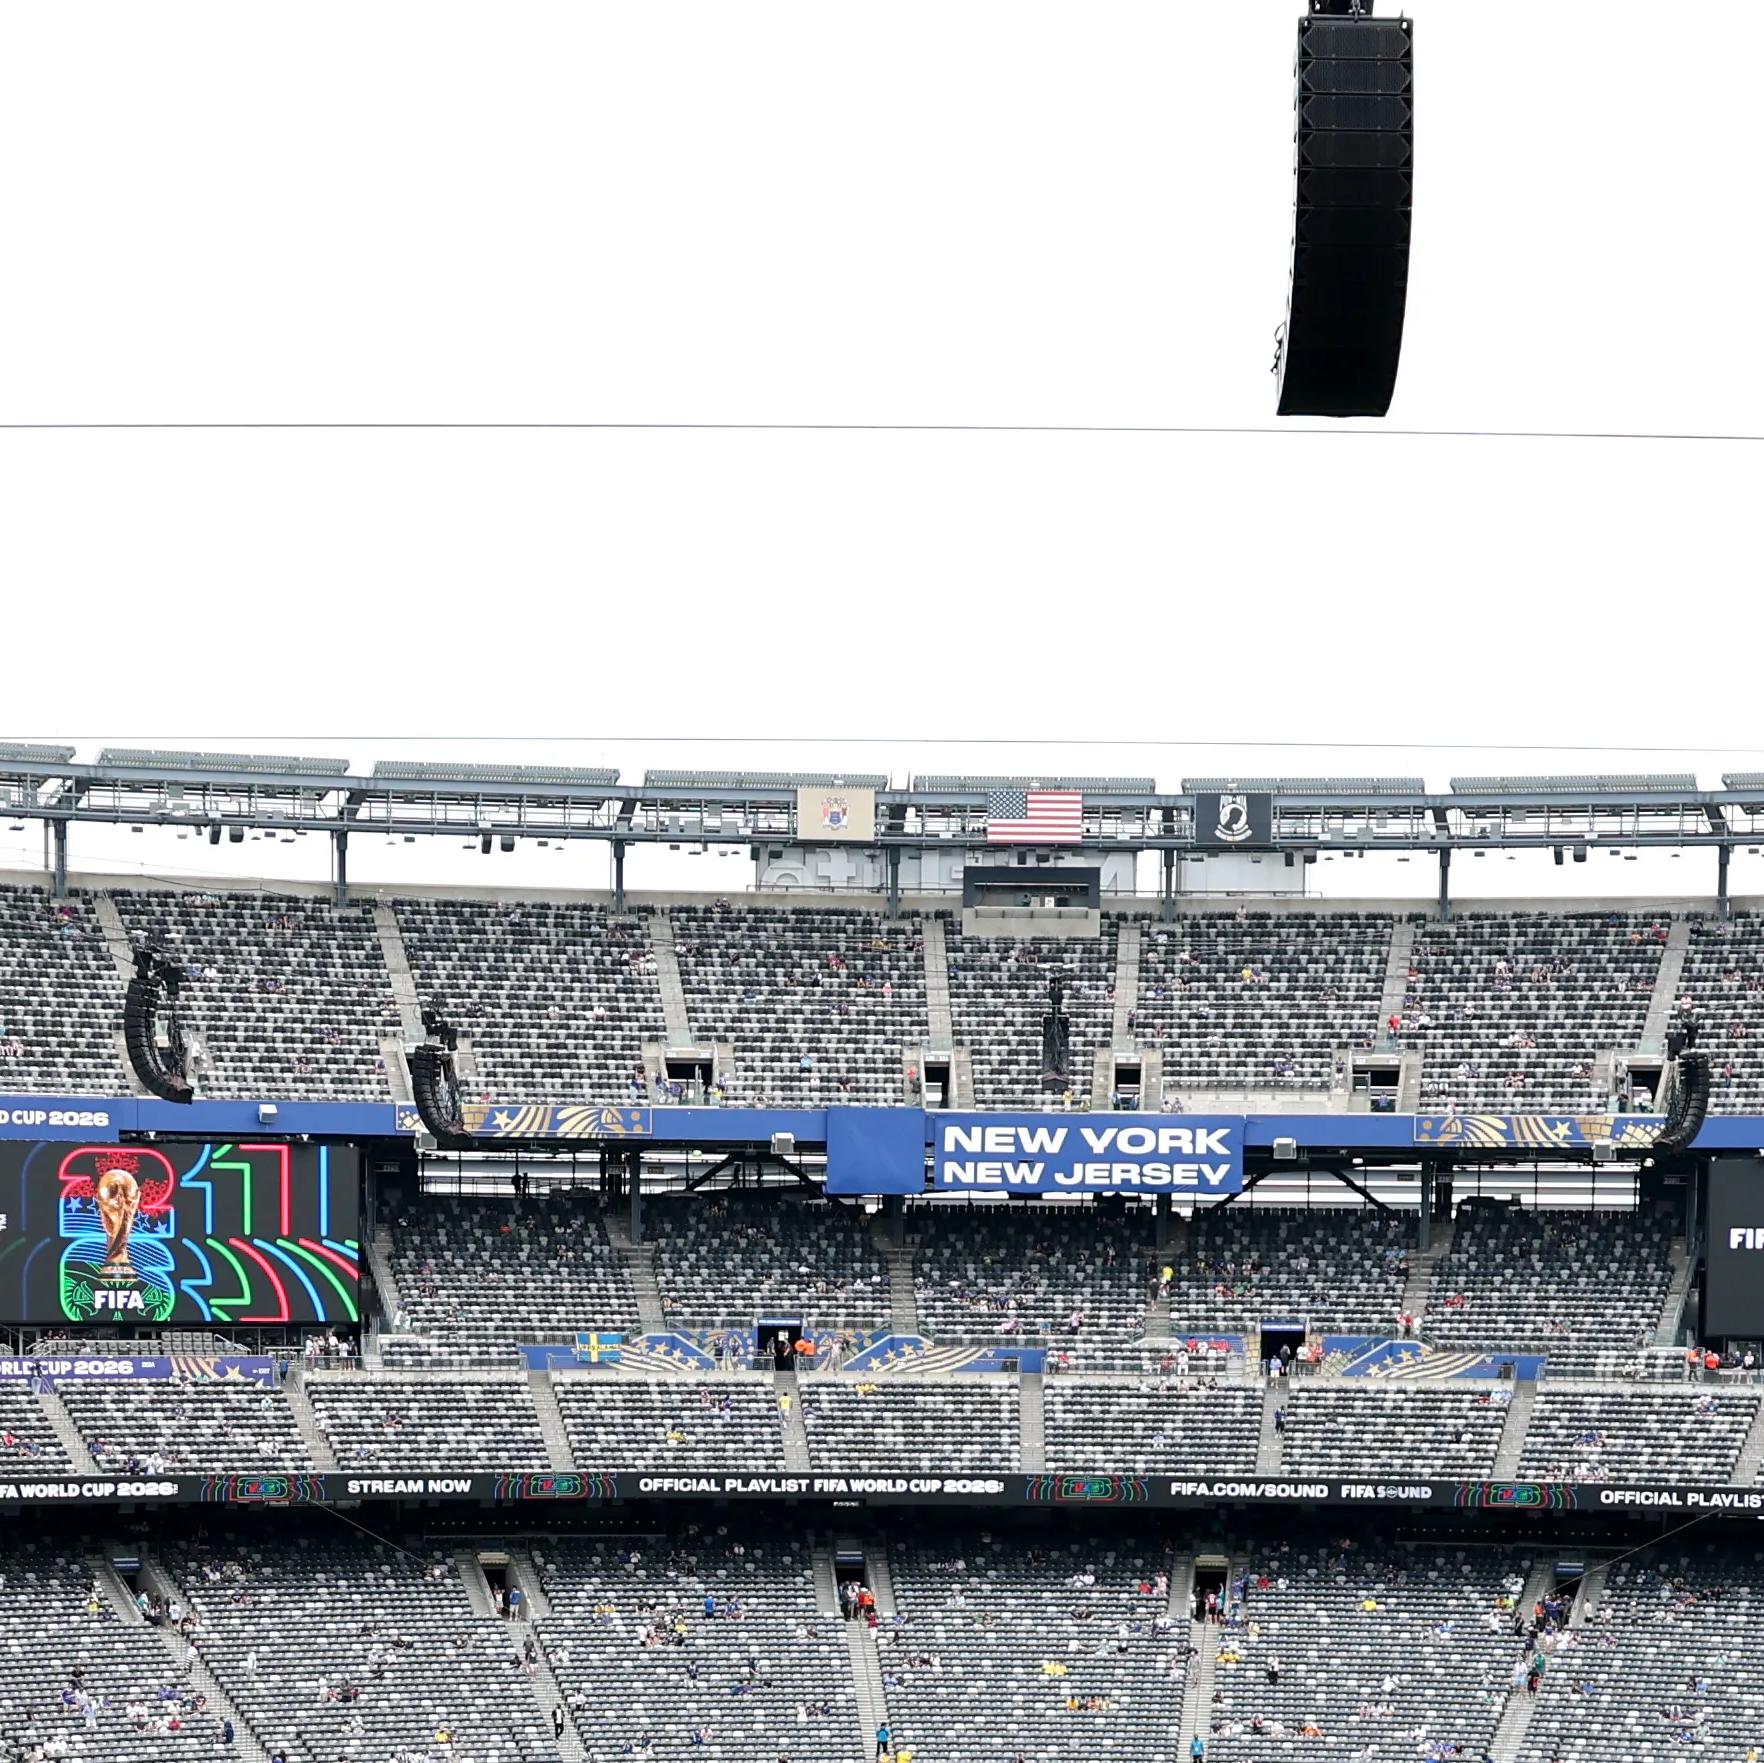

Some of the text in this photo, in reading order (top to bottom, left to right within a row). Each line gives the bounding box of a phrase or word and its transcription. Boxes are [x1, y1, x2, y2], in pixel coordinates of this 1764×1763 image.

[12, 1110, 46, 1125] CUP
[48, 1111, 109, 1126] 2026
[943, 1127, 1231, 1154] NEW YORK
[943, 1161, 1231, 1185] NEW JERSEY
[95, 1290, 144, 1309] FIFA
[37, 1361, 72, 1375] CUP
[74, 1361, 134, 1375] 2026
[19, 1484, 80, 1497] WORLD
[83, 1483, 116, 1496] CUP
[348, 1480, 472, 1493] STREAM NOW
[639, 1480, 721, 1493] OFFICIAL
[725, 1480, 809, 1493] PLAYLIST
[814, 1480, 847, 1493] FIFA
[848, 1480, 908, 1493] WORLD
[910, 1480, 942, 1493] CUP
[1170, 1482, 1328, 1499] FIFA.COM/SOUND
[1601, 1490, 1684, 1507] OFFICIAL
